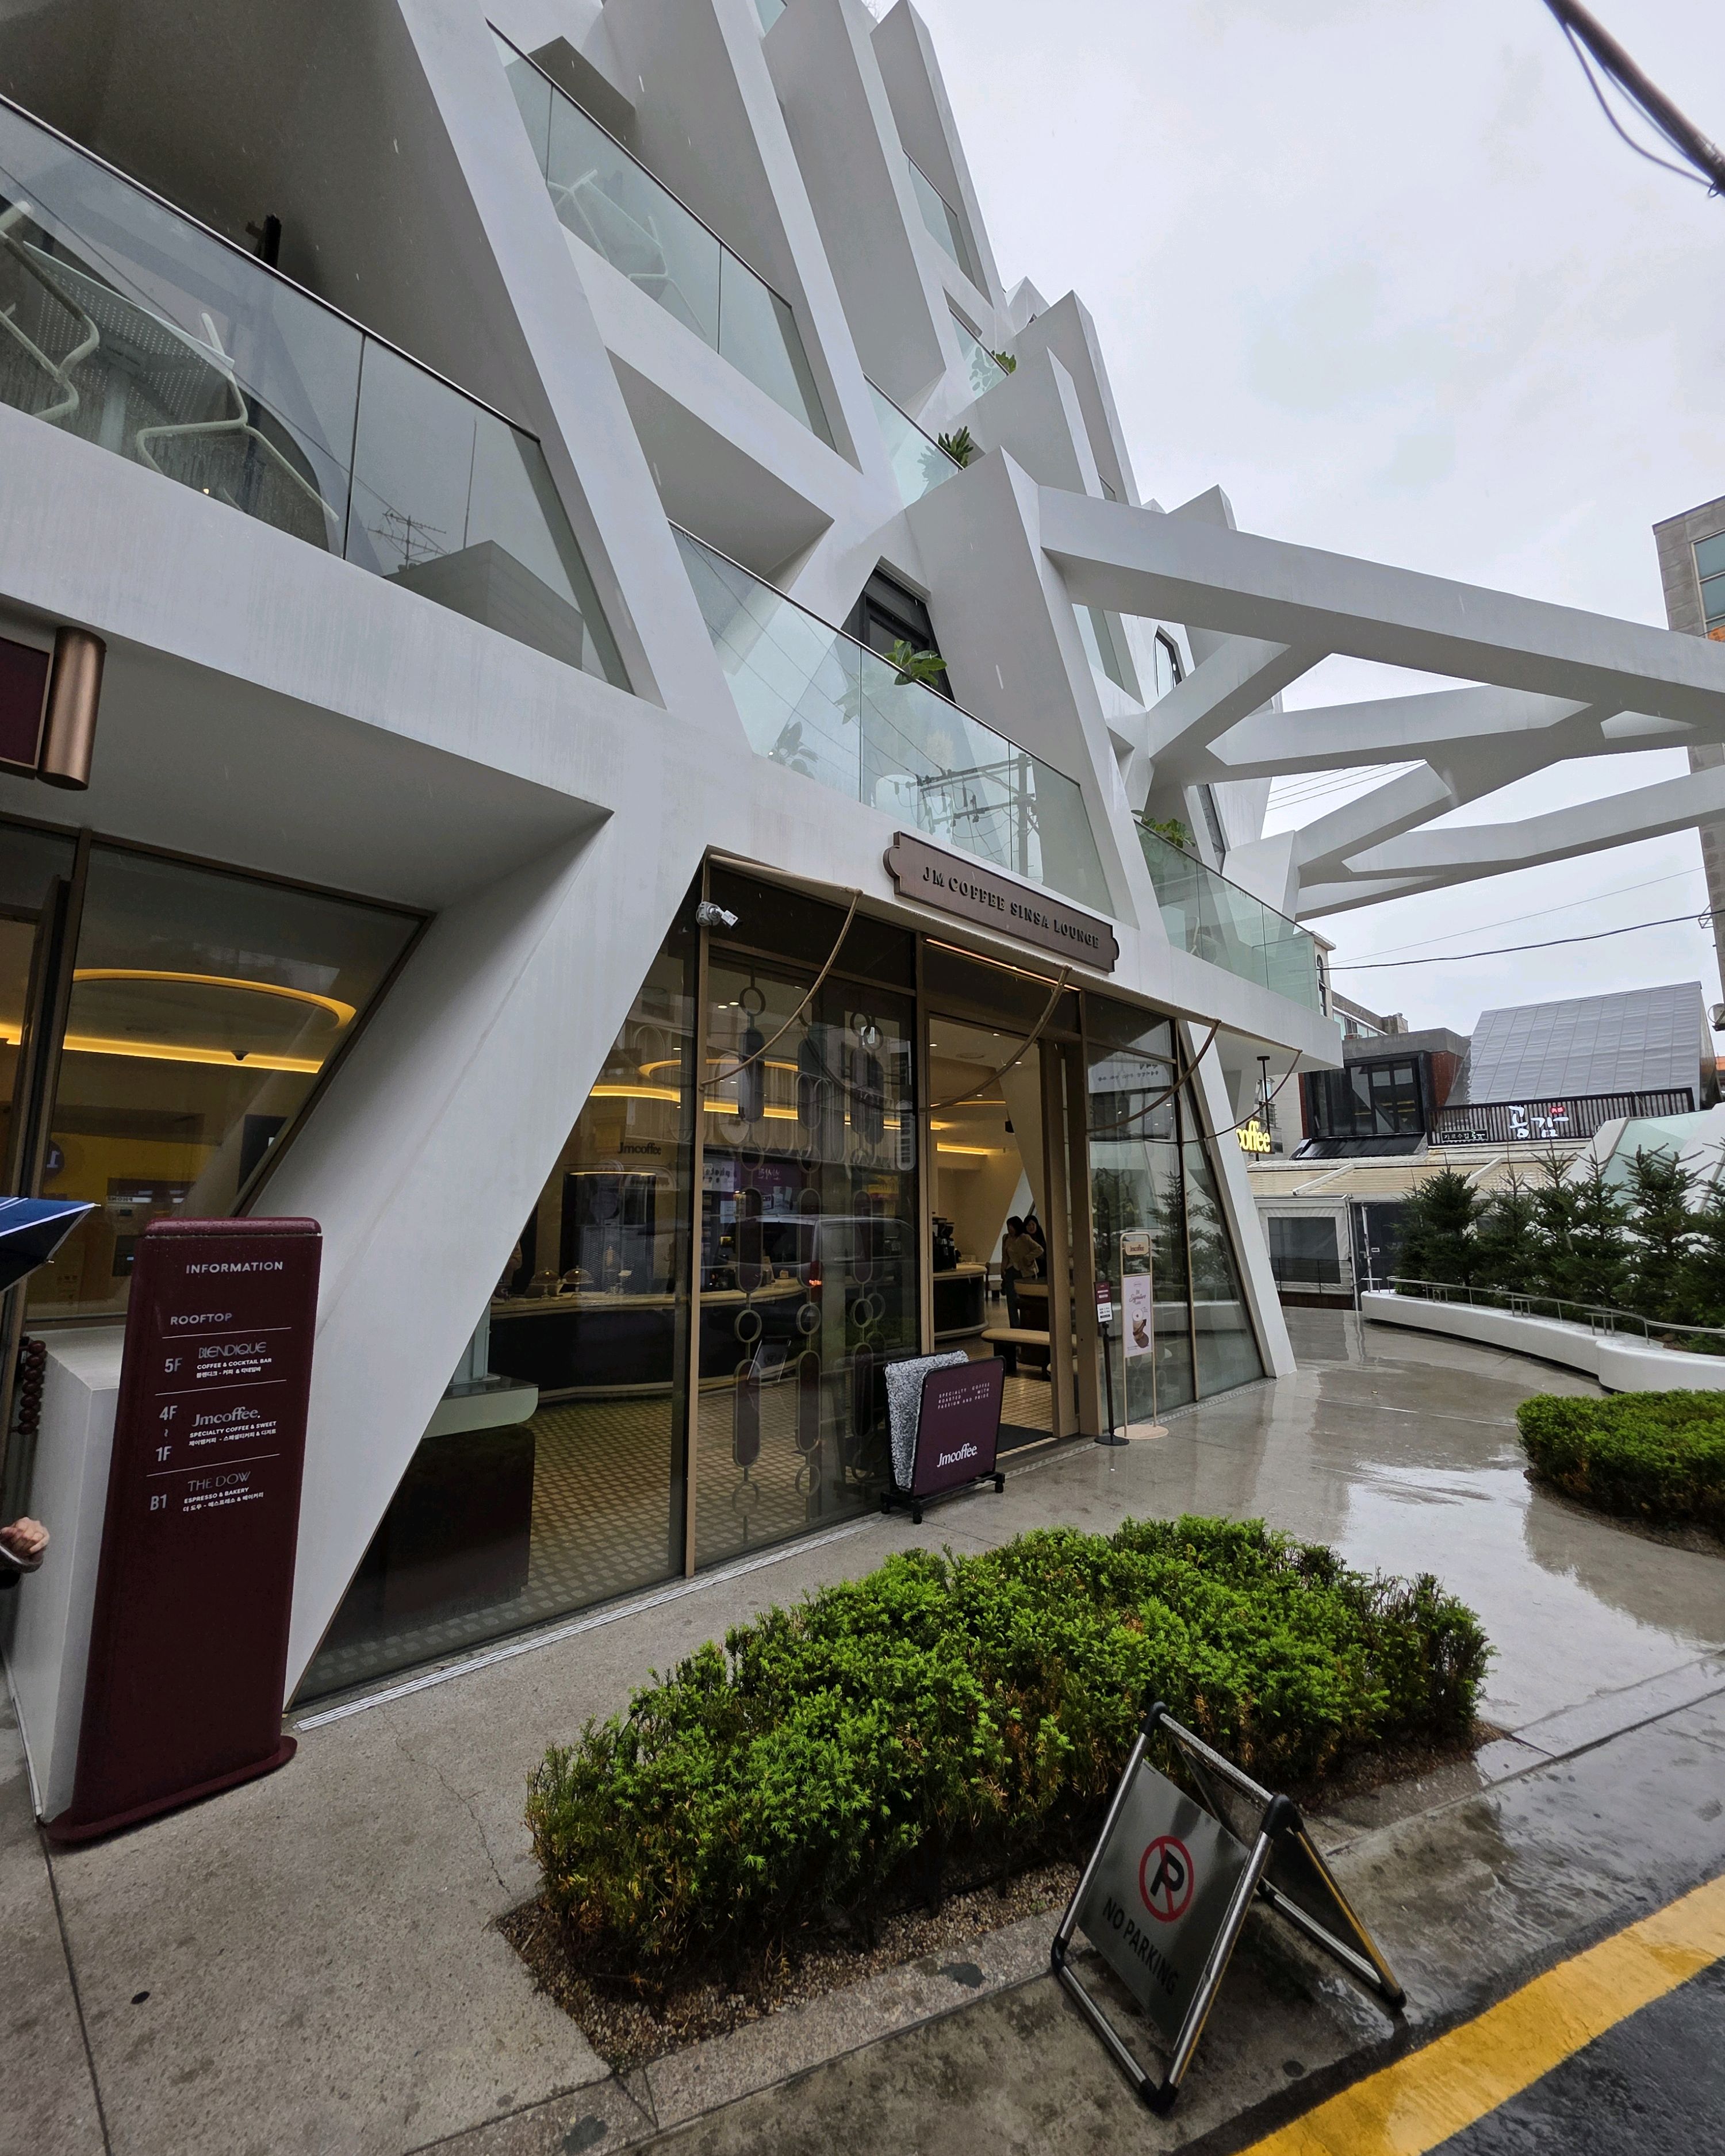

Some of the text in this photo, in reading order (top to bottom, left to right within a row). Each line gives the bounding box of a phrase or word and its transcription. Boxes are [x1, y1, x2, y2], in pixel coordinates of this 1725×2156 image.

[922, 866, 1099, 949] JM COFFEE SINSA LOUNGE
[186, 1261, 283, 1274] INFORMATION
[170, 1313, 232, 1325] ROOFTOP
[198, 1341, 267, 1359] BLENDIQUE
[164, 1357, 183, 1373] 5F
[228, 1359, 259, 1367] COCKTAIL
[939, 1382, 990, 1398] SPECIALTY COFFEE
[159, 1405, 178, 1421] 4F
[189, 1428, 225, 1438] SPECIALTY
[256, 1421, 277, 1429] SWEET
[155, 1445, 172, 1462] 1F
[187, 1471, 251, 1492] THE DOW
[150, 1494, 167, 1511] B1
[184, 1493, 217, 1504] ESPRESSO
[224, 1487, 250, 1497] BAKERY
[1102, 1897, 1179, 1996] NO PARKING
